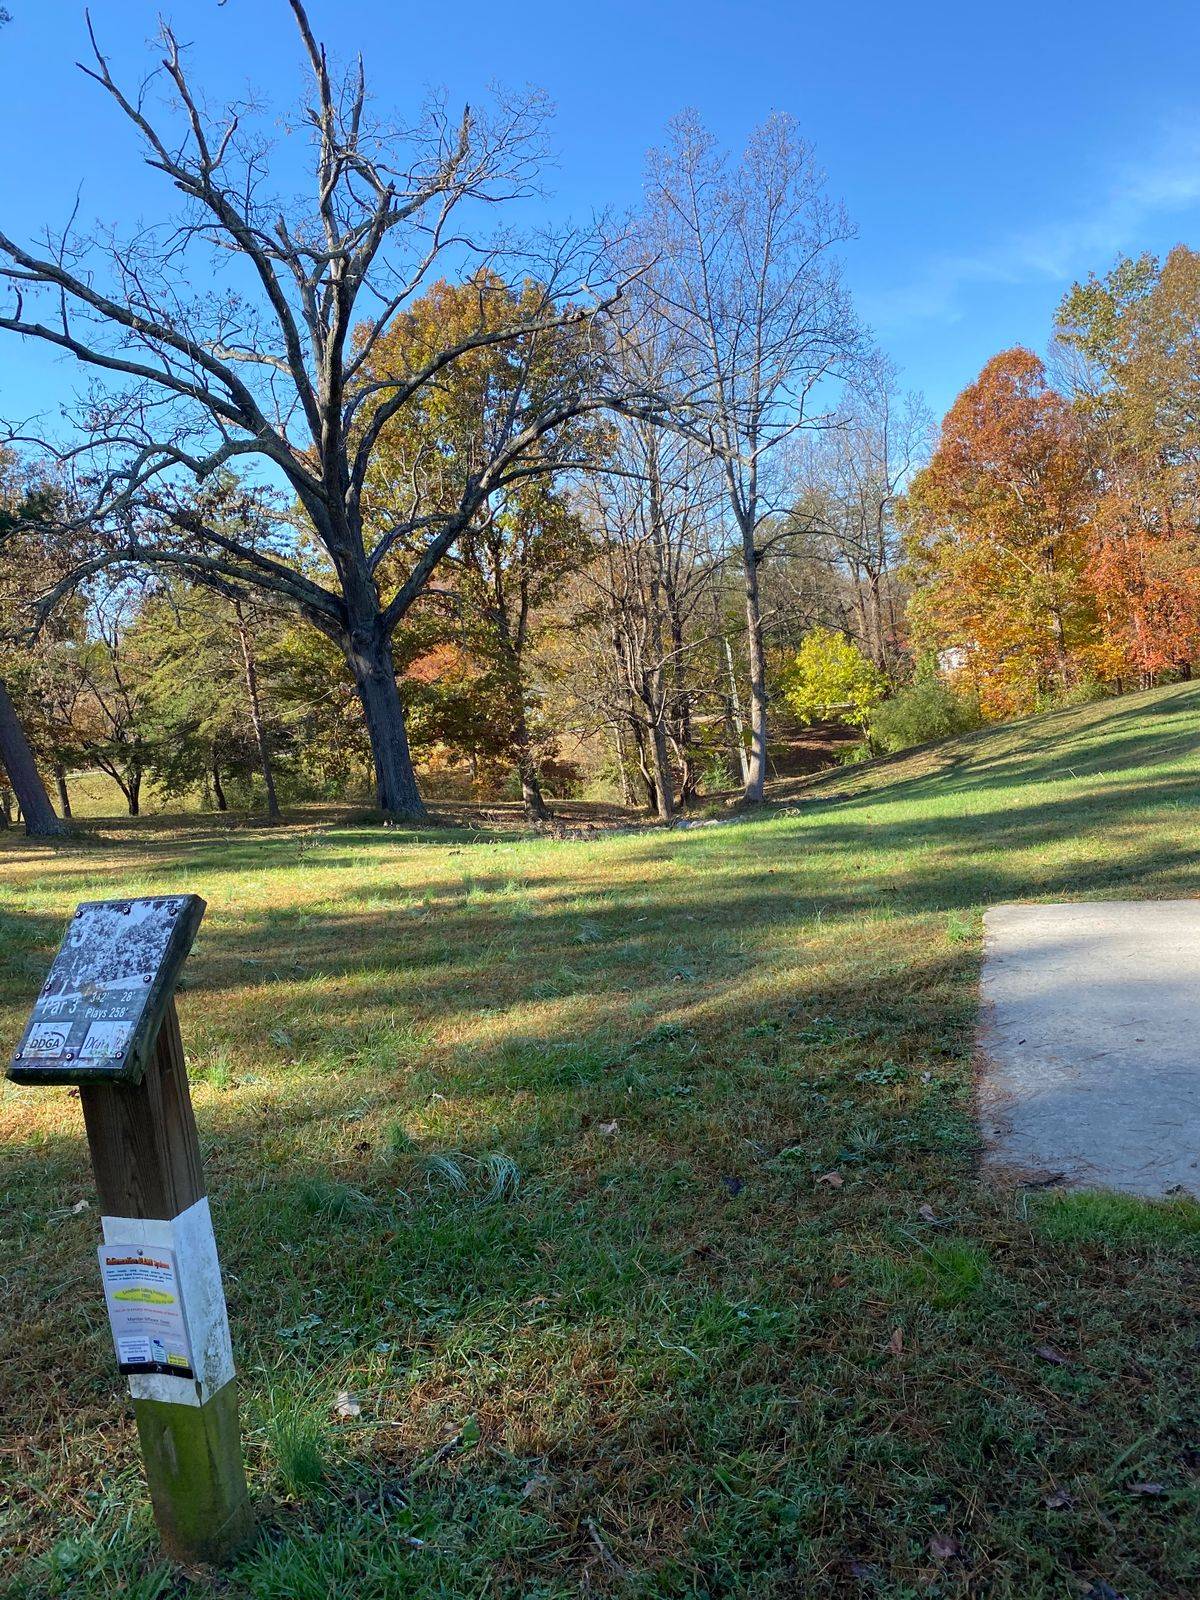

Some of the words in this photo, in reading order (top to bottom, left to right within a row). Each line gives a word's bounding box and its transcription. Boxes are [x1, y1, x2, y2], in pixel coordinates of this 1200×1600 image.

[42, 996, 68, 1015] Par
[69, 997, 79, 1014] 3
[85, 1008, 107, 1021] Plays
[30, 1038, 60, 1050] DDGA
